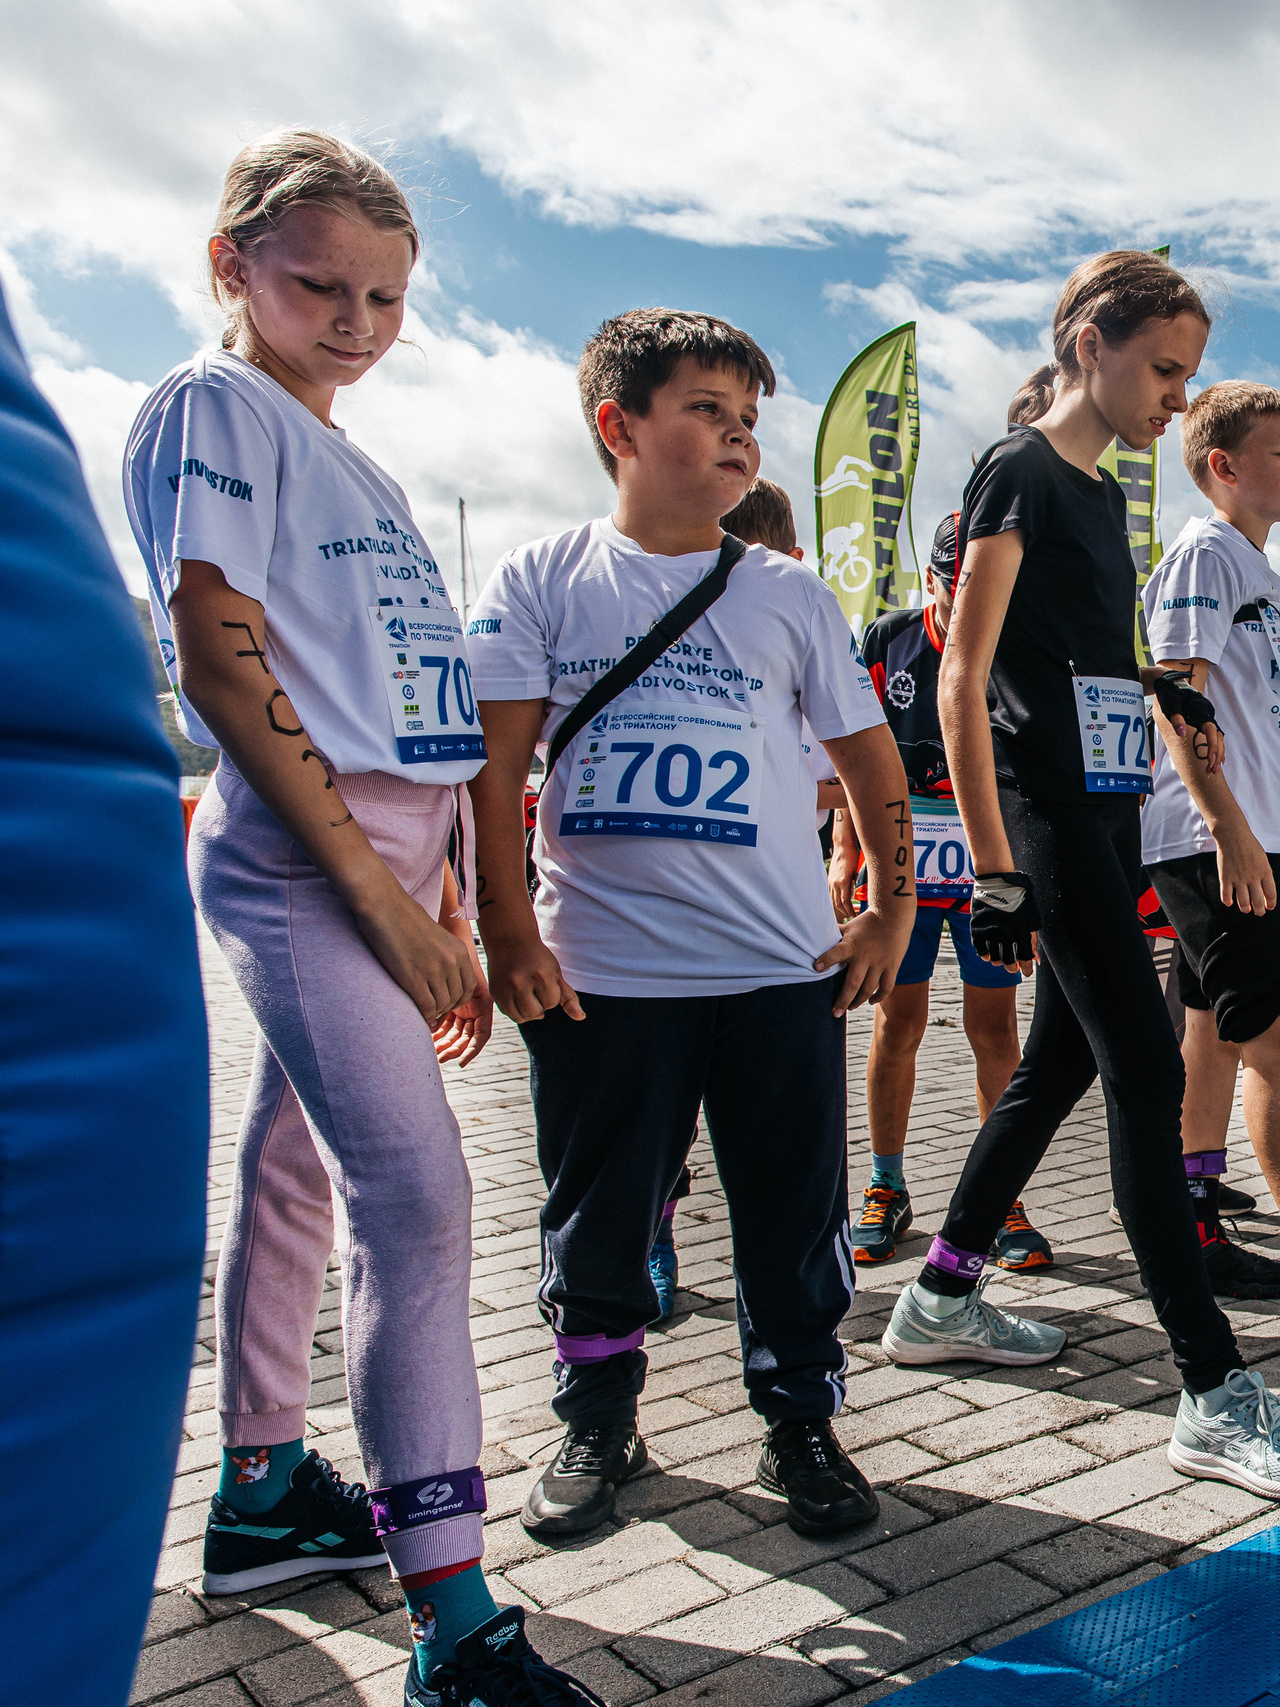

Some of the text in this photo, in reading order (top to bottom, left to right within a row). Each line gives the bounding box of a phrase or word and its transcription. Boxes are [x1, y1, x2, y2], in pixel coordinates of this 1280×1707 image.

[904, 350, 920, 462] CENTRE DV
[1163, 595, 1220, 612] VLADIVOSTOK
[410, 633, 455, 643] ПО ТРИАТЛОНУ
[419, 656, 482, 727] 70
[1101, 689, 1136, 699] ВСЕРОССИЙСКИЕ
[611, 713, 742, 731] ВСЕРОССИЙСКИЕ СОРЕВНОВАНИЯ
[623, 722, 677, 731] ТРИАТЛОНУ
[610, 742, 750, 815] 702
[885, 800, 913, 897] 702
[408, 1500, 464, 1520] timingsense
[485, 1621, 520, 1646] Reebok
